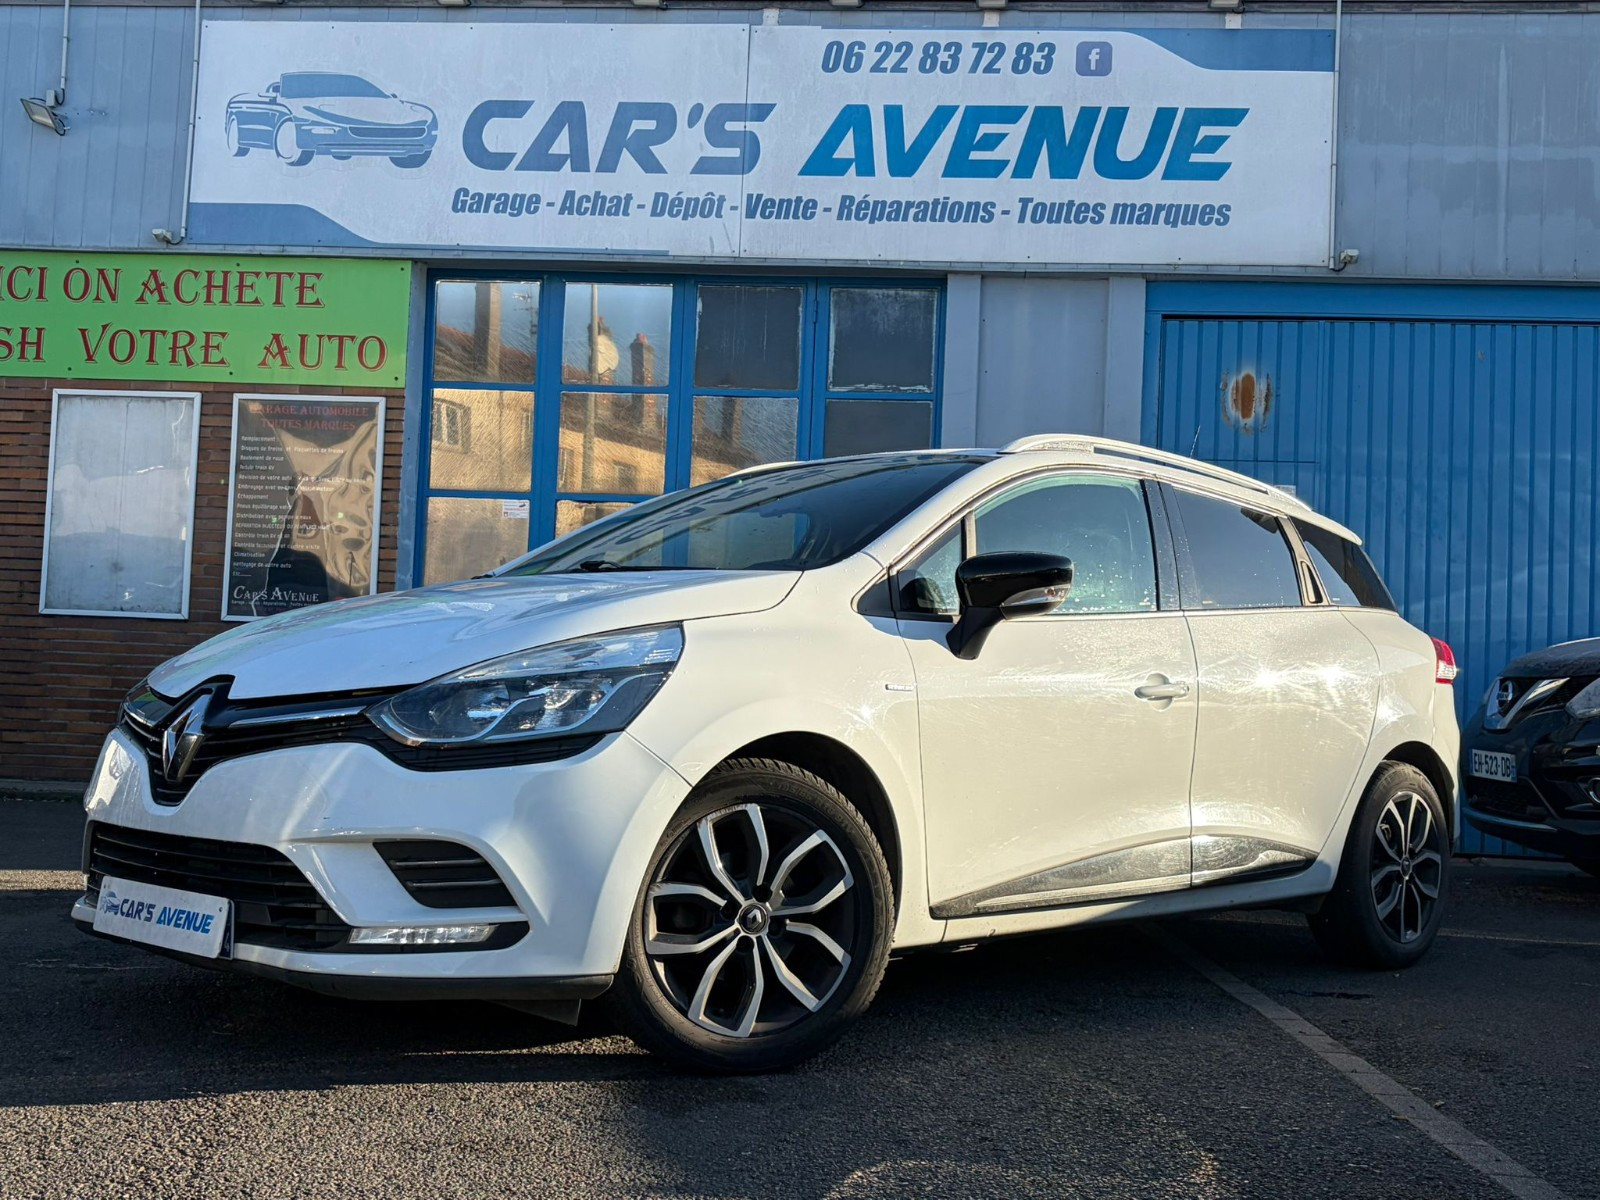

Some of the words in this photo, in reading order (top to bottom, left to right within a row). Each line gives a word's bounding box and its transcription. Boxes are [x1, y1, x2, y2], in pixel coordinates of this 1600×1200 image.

[822, 41, 866, 73] 06
[870, 41, 913, 73] 22
[919, 41, 962, 74] 83
[968, 42, 1006, 74] 72
[1011, 42, 1056, 75] 83
[463, 100, 776, 175] CAR'S
[798, 104, 1249, 181] AVENUE
[452, 188, 541, 217] Garage
[558, 191, 633, 216] Achat
[650, 192, 726, 220] Dépôt
[745, 194, 818, 220] Vente
[837, 195, 996, 224] Réparations
[1018, 198, 1106, 224] Toutes
[1110, 203, 1231, 228] marques
[63, 267, 121, 303] ON
[136, 269, 325, 308] ACHETE
[78, 322, 230, 369] VOTRE
[257, 333, 388, 373] AUTO
[248, 403, 297, 415] ARAGE
[299, 406, 370, 417] AUTOMOBILE
[260, 419, 303, 429] TOUTES
[304, 421, 357, 431] MARQUES
[120, 898, 156, 923] CAR'S
[156, 906, 216, 934] AVENUE
